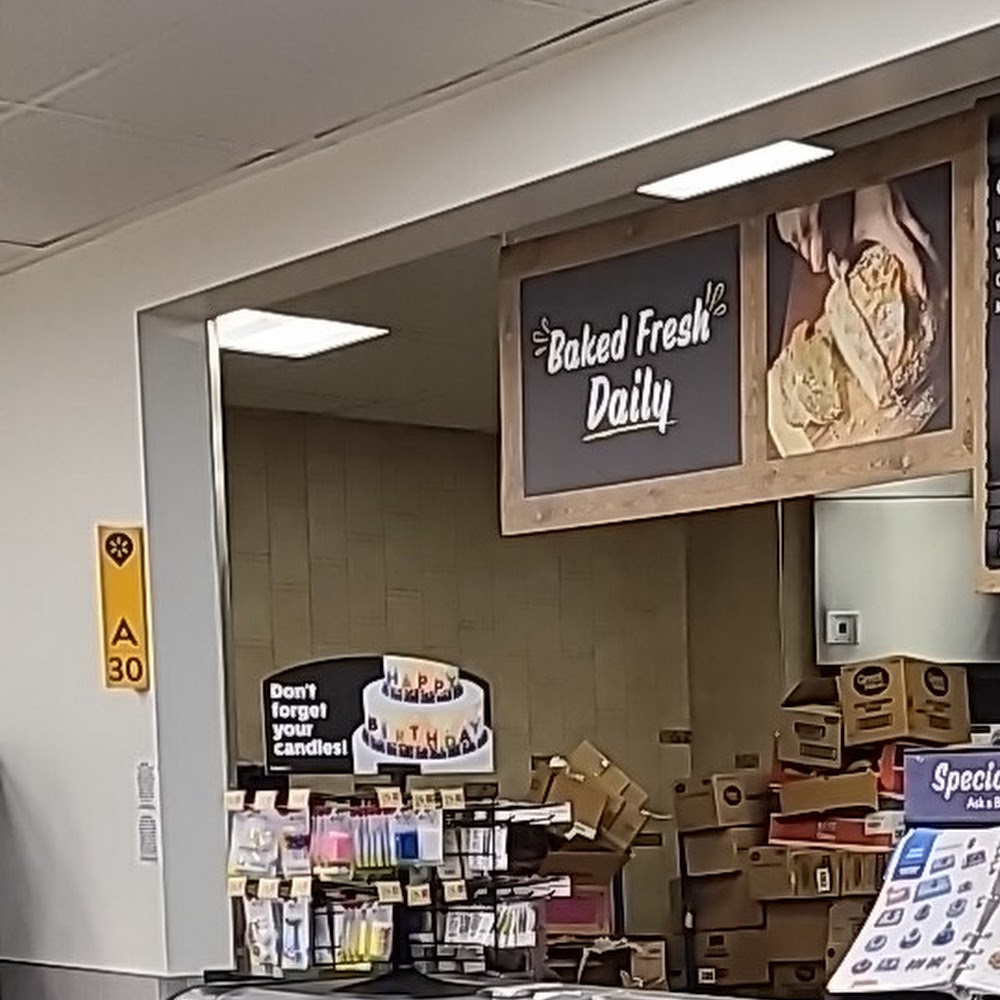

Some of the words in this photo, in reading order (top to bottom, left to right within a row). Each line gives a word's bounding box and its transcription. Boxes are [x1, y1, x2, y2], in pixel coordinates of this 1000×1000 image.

[547, 314, 629, 375] Baked
[635, 297, 711, 357] Fresh
[586, 366, 672, 434] Daily
[111, 618, 138, 646] A
[108, 657, 143, 682] 30
[269, 682, 317, 700] Don't
[270, 702, 328, 722] forget
[272, 723, 314, 741] your
[274, 739, 349, 756] candles!
[966, 797, 985, 809] Ask
[986, 801, 993, 809] a
